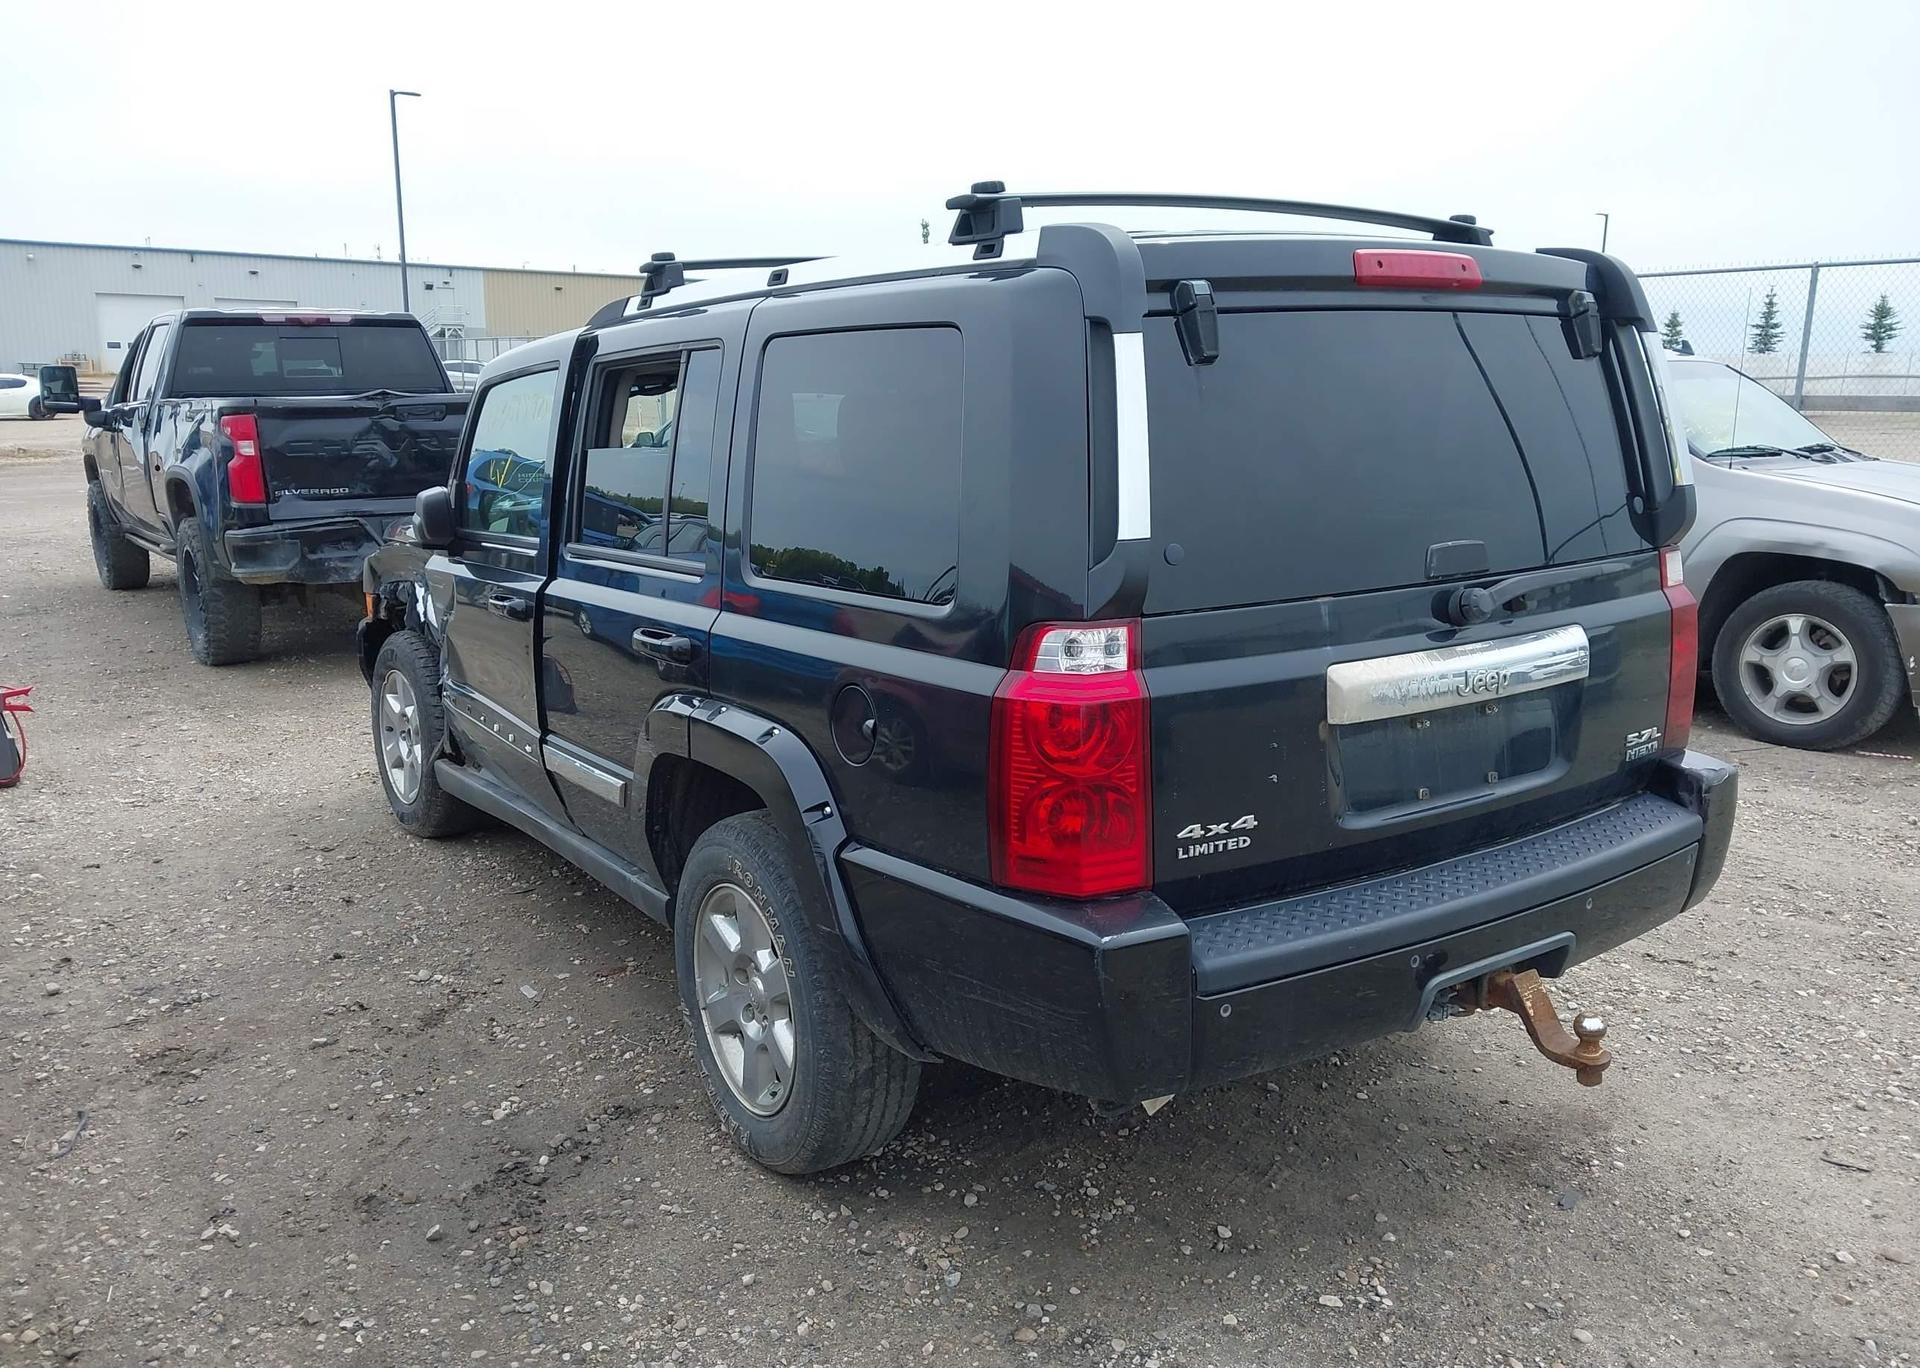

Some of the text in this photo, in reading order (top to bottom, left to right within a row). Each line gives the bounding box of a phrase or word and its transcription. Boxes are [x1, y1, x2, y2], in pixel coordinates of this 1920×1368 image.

[274, 487, 350, 497] SILVERADO
[1456, 667, 1511, 698] Jeep
[1625, 740, 1659, 762] HEMI
[1177, 836, 1252, 860] LIMITED
[727, 855, 797, 978] IRONMAN
